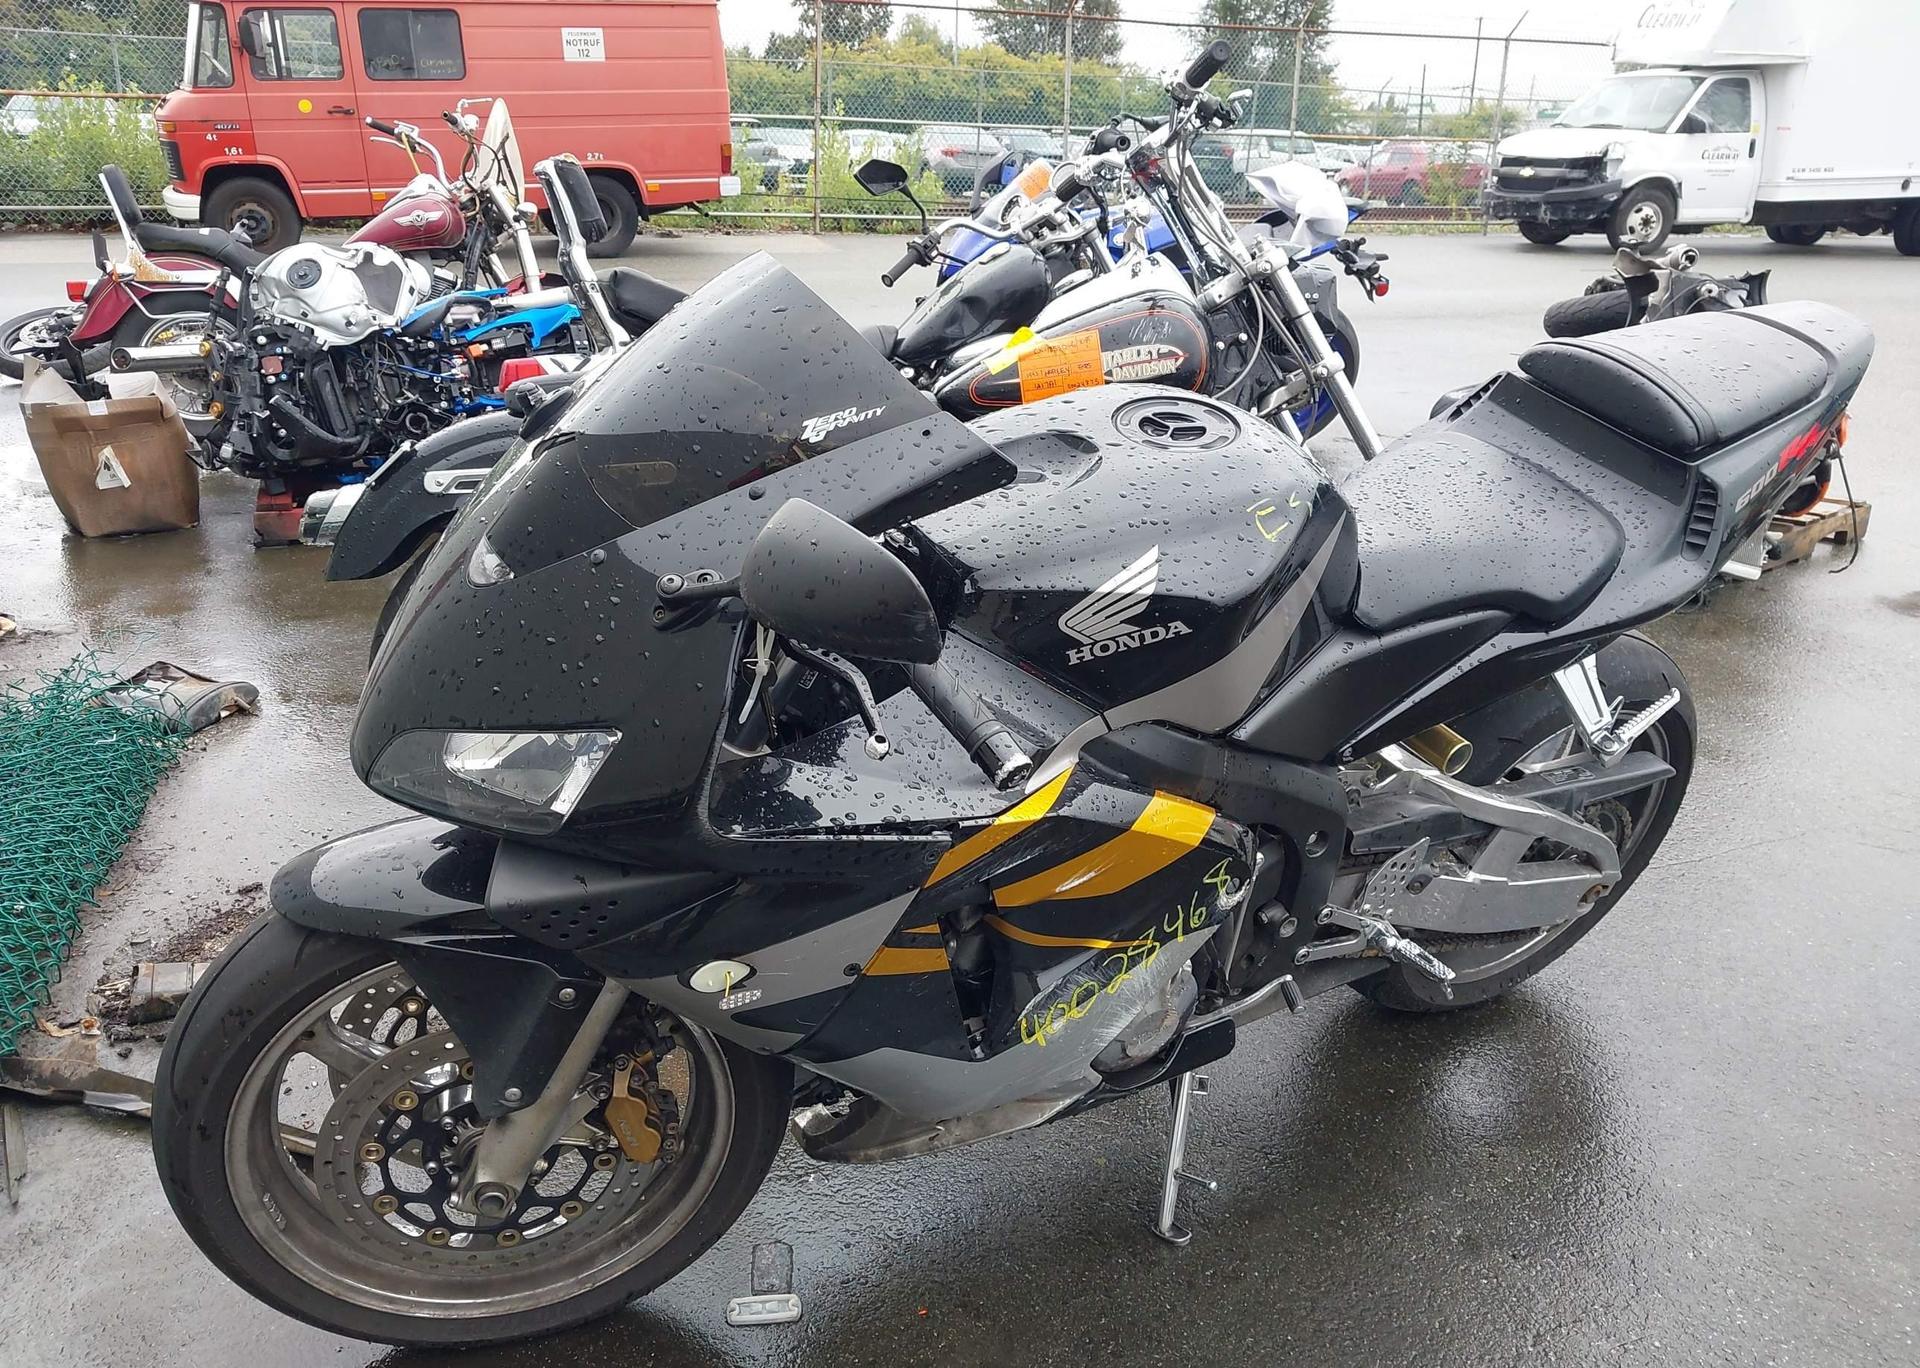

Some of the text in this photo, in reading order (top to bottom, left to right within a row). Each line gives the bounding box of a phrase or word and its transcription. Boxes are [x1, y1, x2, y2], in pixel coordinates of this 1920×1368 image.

[565, 38, 601, 47] NOTRUF
[577, 48, 591, 58] 112
[1103, 345, 1160, 371] HARLEY
[1112, 359, 1178, 381] DAVIDSON
[801, 406, 858, 441] ZERO
[808, 405, 887, 443] GRAVITY
[1735, 462, 1779, 513] 600
[1065, 620, 1193, 666] HONDA
